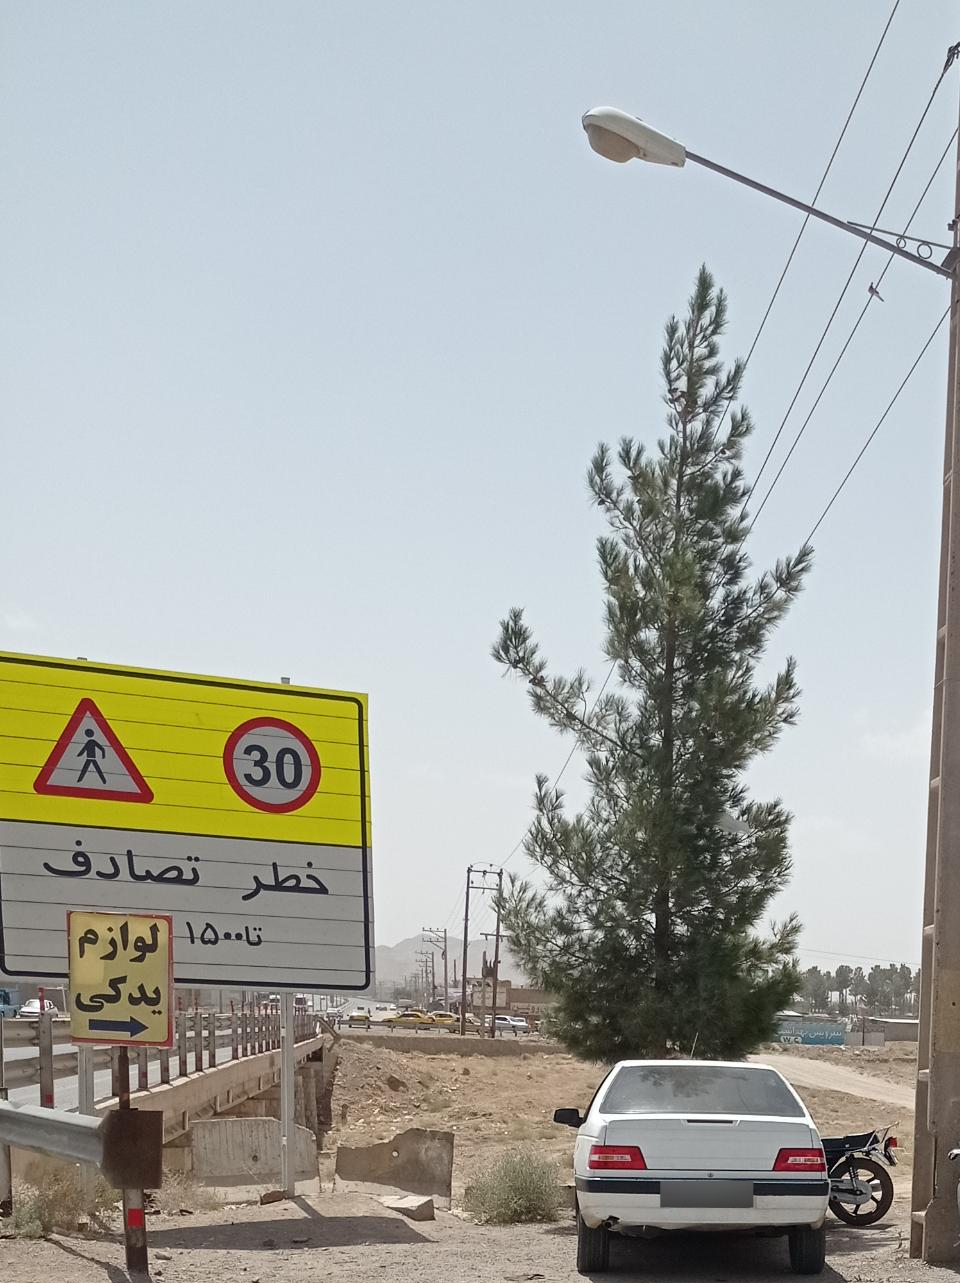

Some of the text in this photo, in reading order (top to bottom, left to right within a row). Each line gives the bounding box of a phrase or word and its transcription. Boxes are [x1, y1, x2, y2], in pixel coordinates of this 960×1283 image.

[242, 744, 303, 790] 30
[43, 840, 330, 901] خطر تصادف
[77, 921, 160, 963] لوازم
[75, 975, 163, 1016] یدکی
